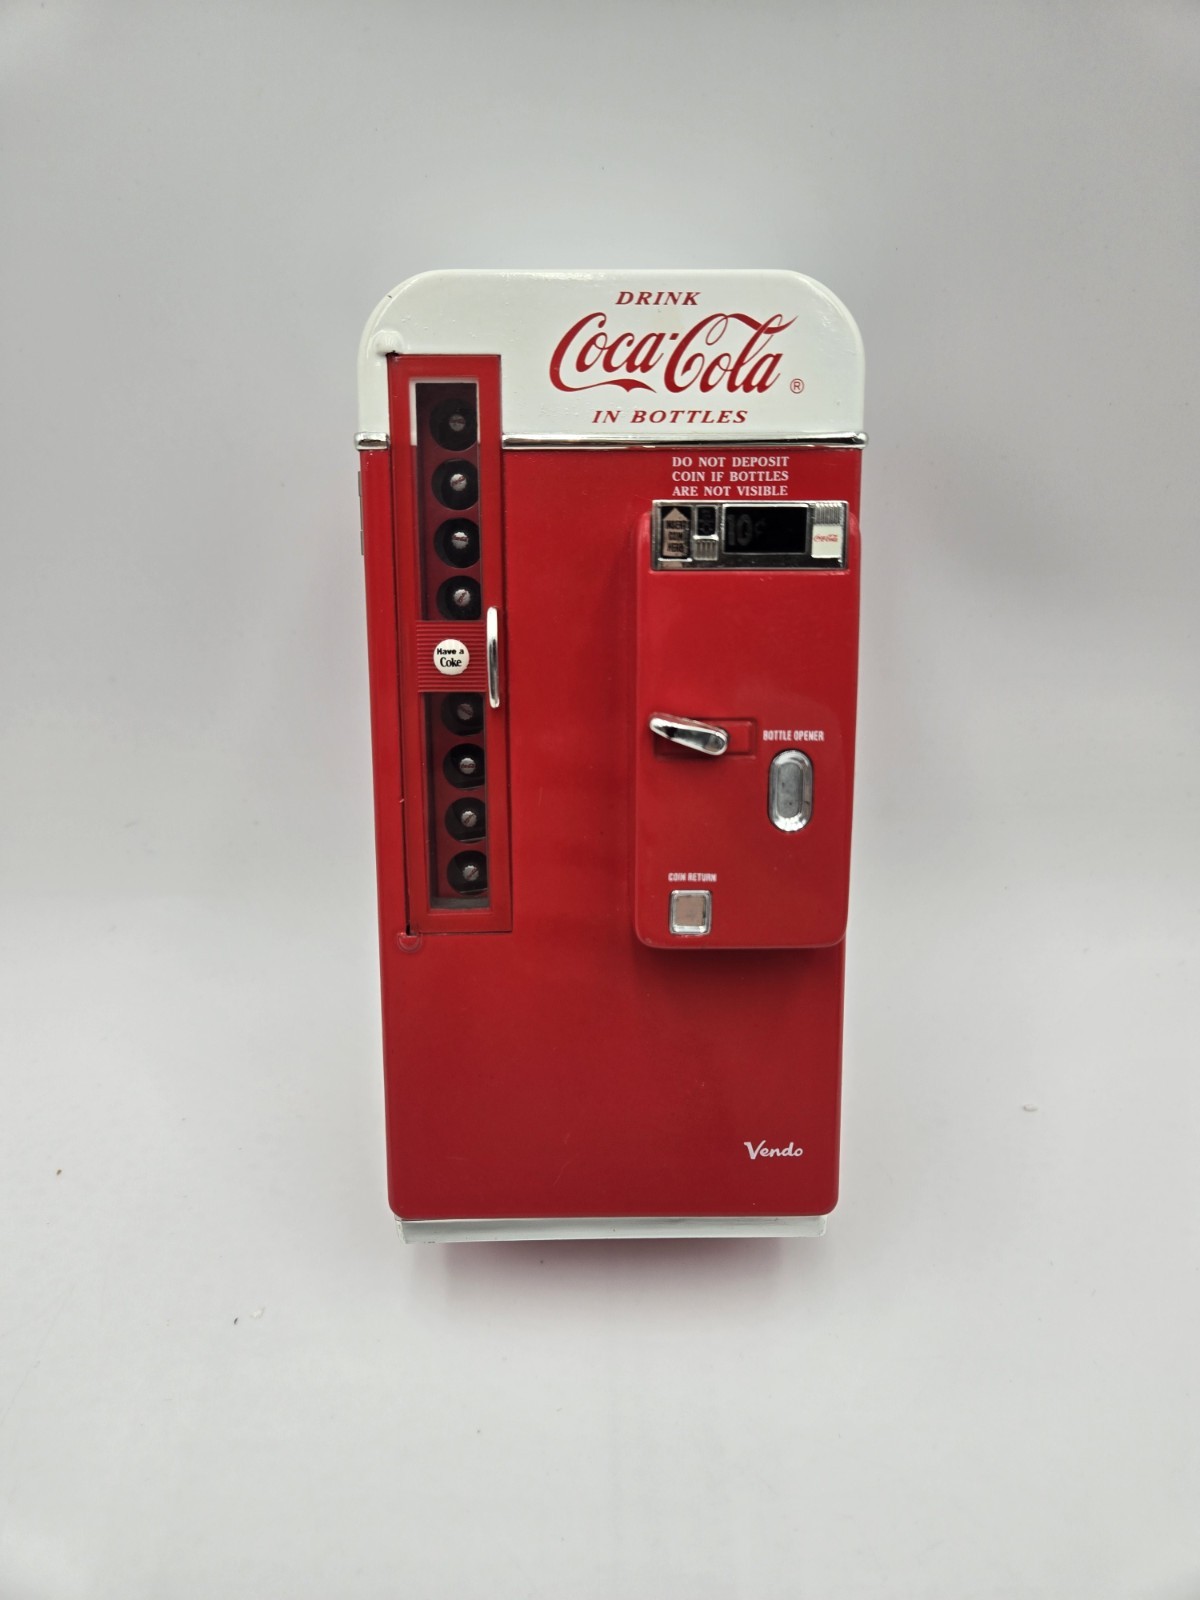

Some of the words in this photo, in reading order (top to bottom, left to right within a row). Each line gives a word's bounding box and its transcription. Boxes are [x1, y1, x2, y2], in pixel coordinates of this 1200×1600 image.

[615, 291, 702, 306] DRINK
[549, 311, 799, 394] Coca-Cola
[592, 410, 621, 424] IN
[631, 410, 749, 424] BOTTLES
[672, 456, 693, 467] DO
[698, 456, 726, 467] NOT
[732, 456, 790, 467] DEPOSIT
[672, 471, 705, 482] COIN
[711, 471, 724, 482] IF
[729, 471, 790, 482] BOTTLES
[672, 486, 698, 496] ARE
[704, 486, 731, 496] NOT
[737, 485, 789, 496] VISIBLE
[440, 656, 462, 667] Coke
[763, 730, 792, 741] BOTTLE
[794, 730, 825, 741] OPENER
[668, 873, 686, 882] COIN
[687, 873, 717, 882] RETURN
[743, 1140, 804, 1160] Vendo
